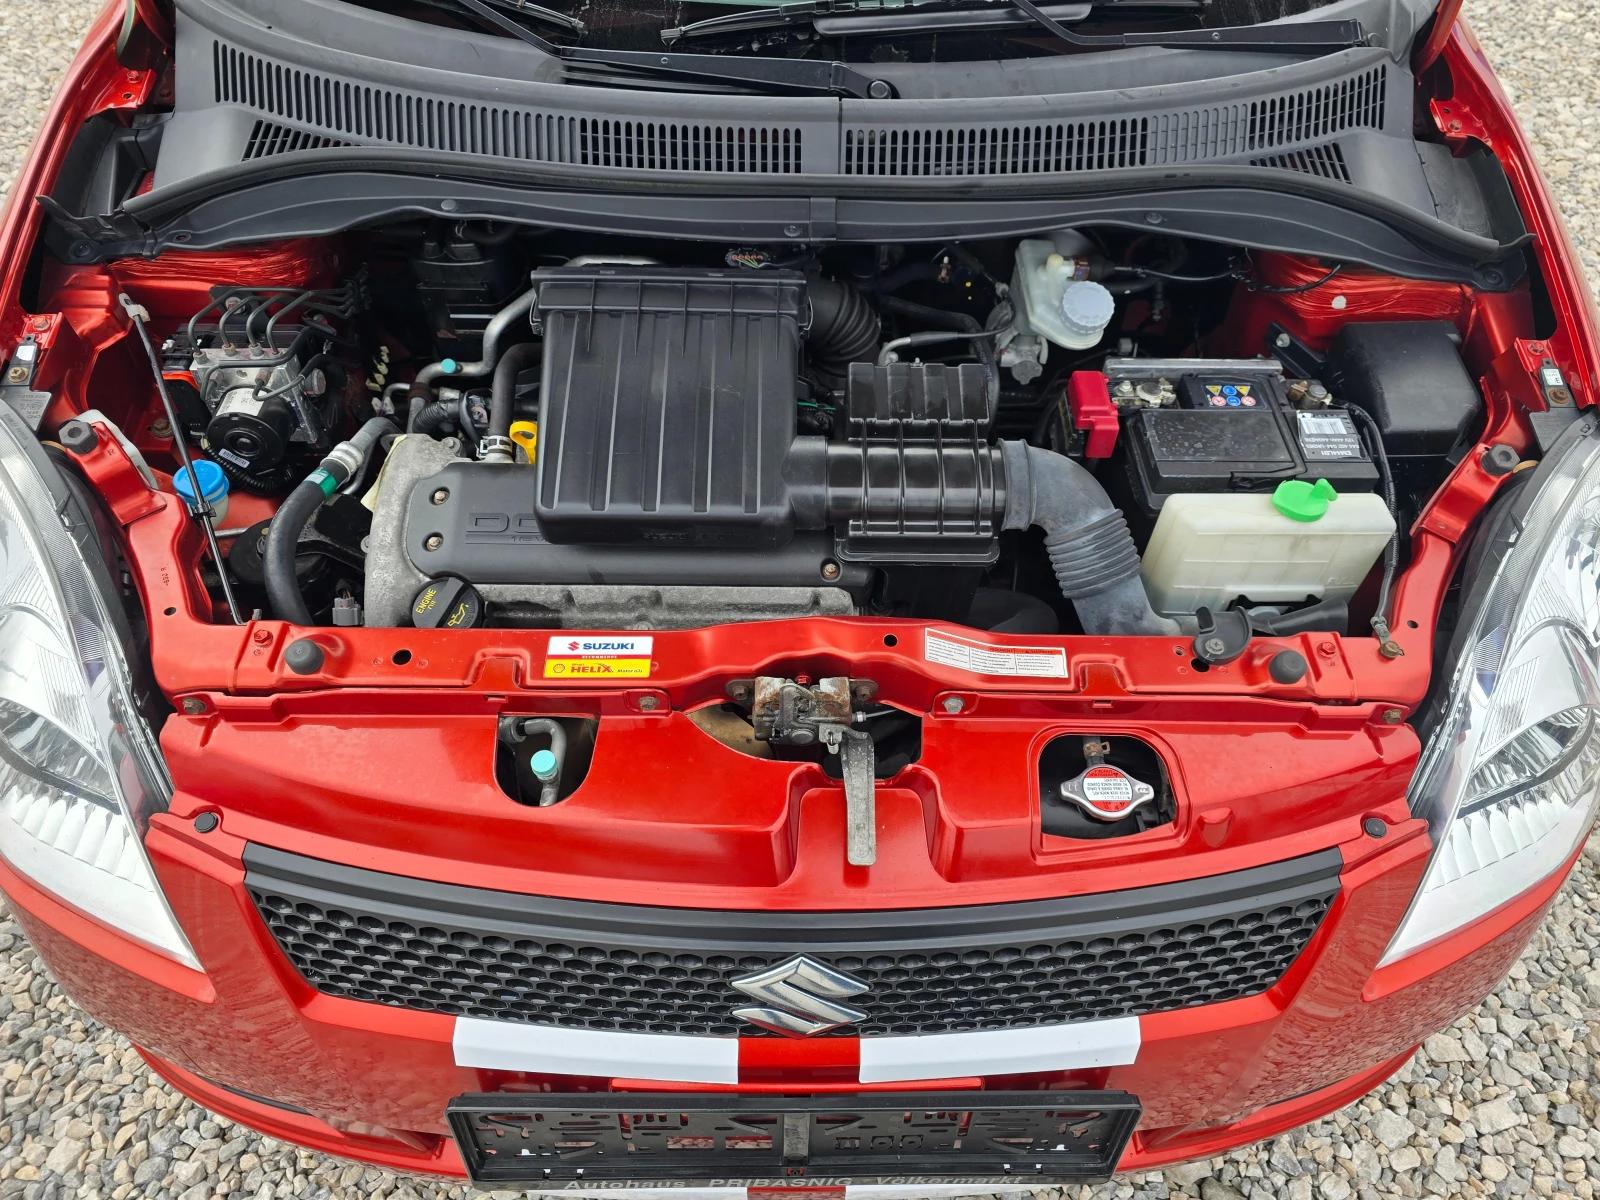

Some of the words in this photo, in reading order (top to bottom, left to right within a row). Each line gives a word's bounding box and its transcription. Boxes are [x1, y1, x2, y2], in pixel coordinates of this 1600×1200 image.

[466, 512, 539, 533] DO
[415, 588, 437, 614] ENGINE
[582, 642, 635, 650] SUZUKI
[570, 665, 613, 673] HELIX
[564, 1180, 686, 1190] Autohaus
[708, 1178, 853, 1188] PRIBASNIG
[876, 1175, 1023, 1185] Völkermarkt
